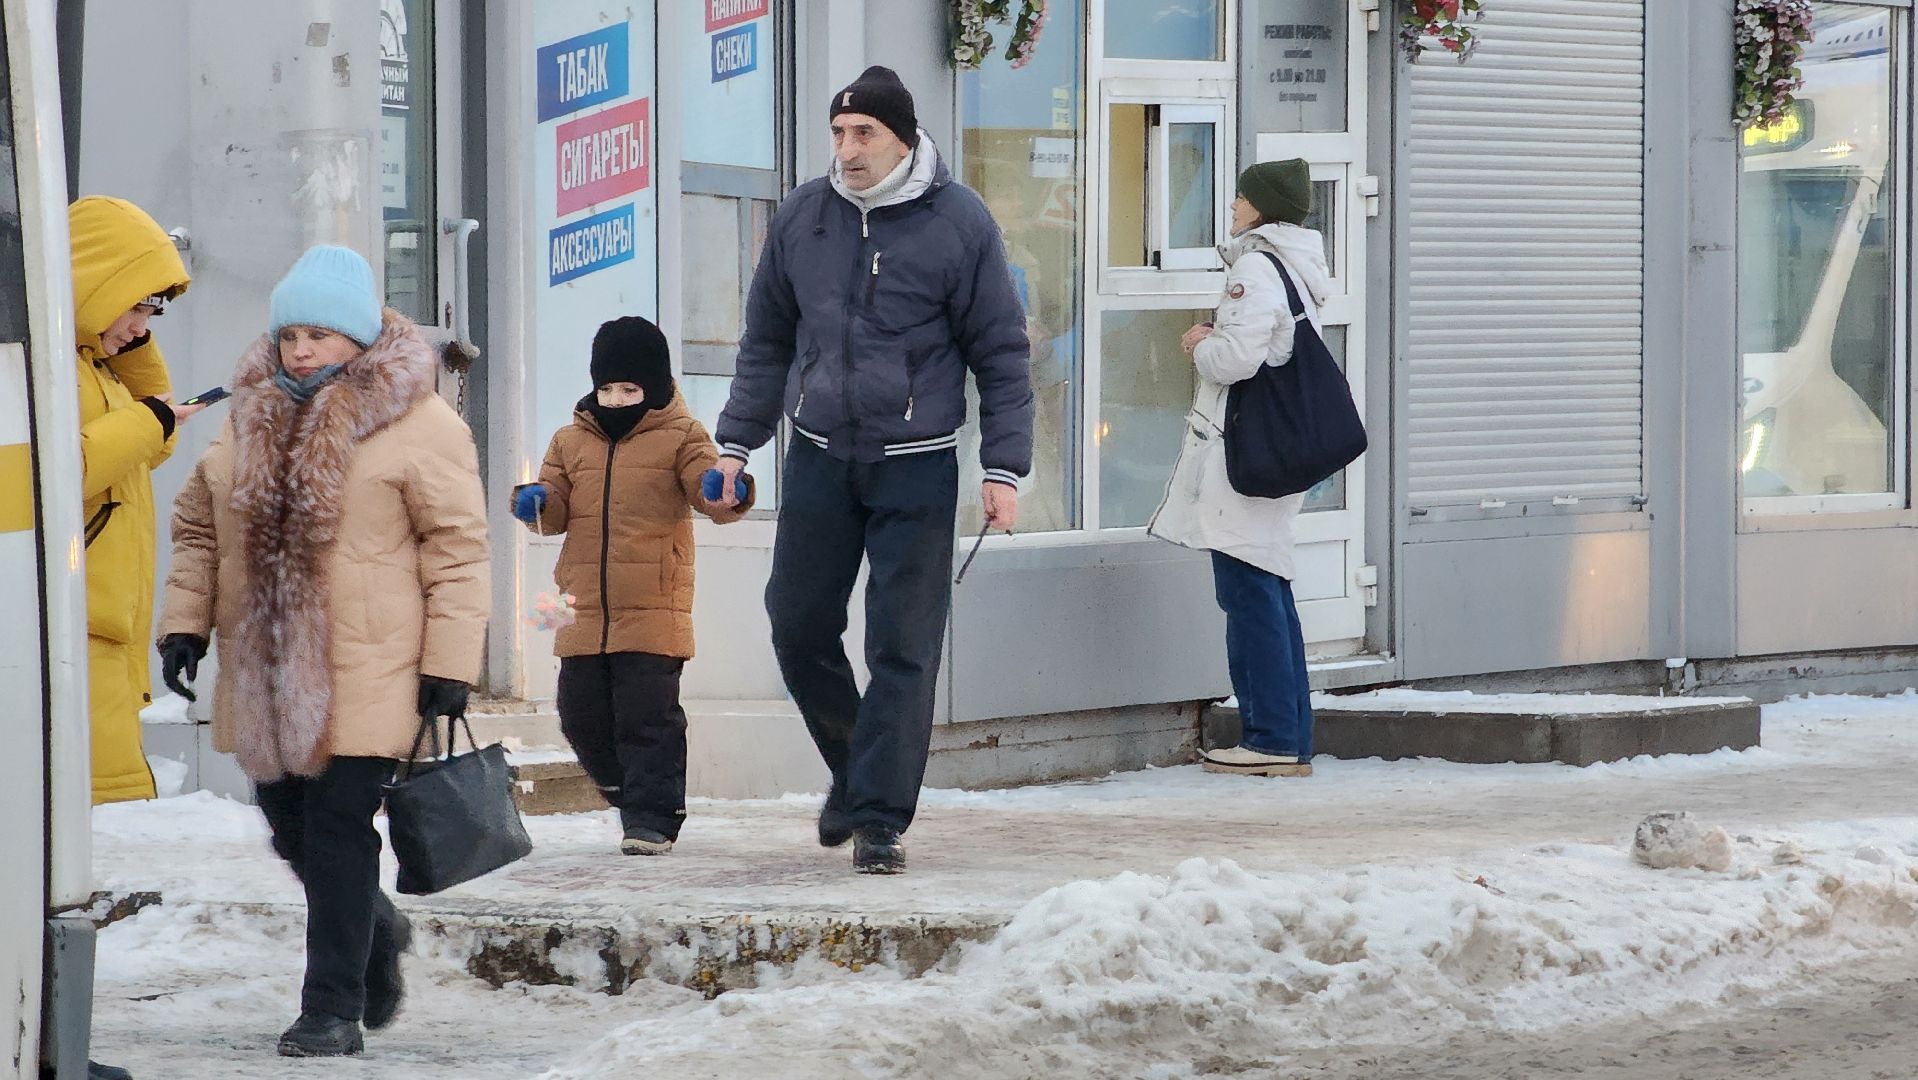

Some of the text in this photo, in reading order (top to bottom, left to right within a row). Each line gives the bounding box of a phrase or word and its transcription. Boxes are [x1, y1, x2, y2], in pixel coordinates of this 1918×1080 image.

[381, 64, 408, 82] ЧНЫЙ
[557, 42, 608, 103] ТАБАК
[716, 31, 751, 74] СНЕКИ
[382, 84, 404, 101] ИТАН
[561, 120, 643, 191] СИГАРЕТЫ
[552, 214, 631, 275] АКСЕССУАРЫ
